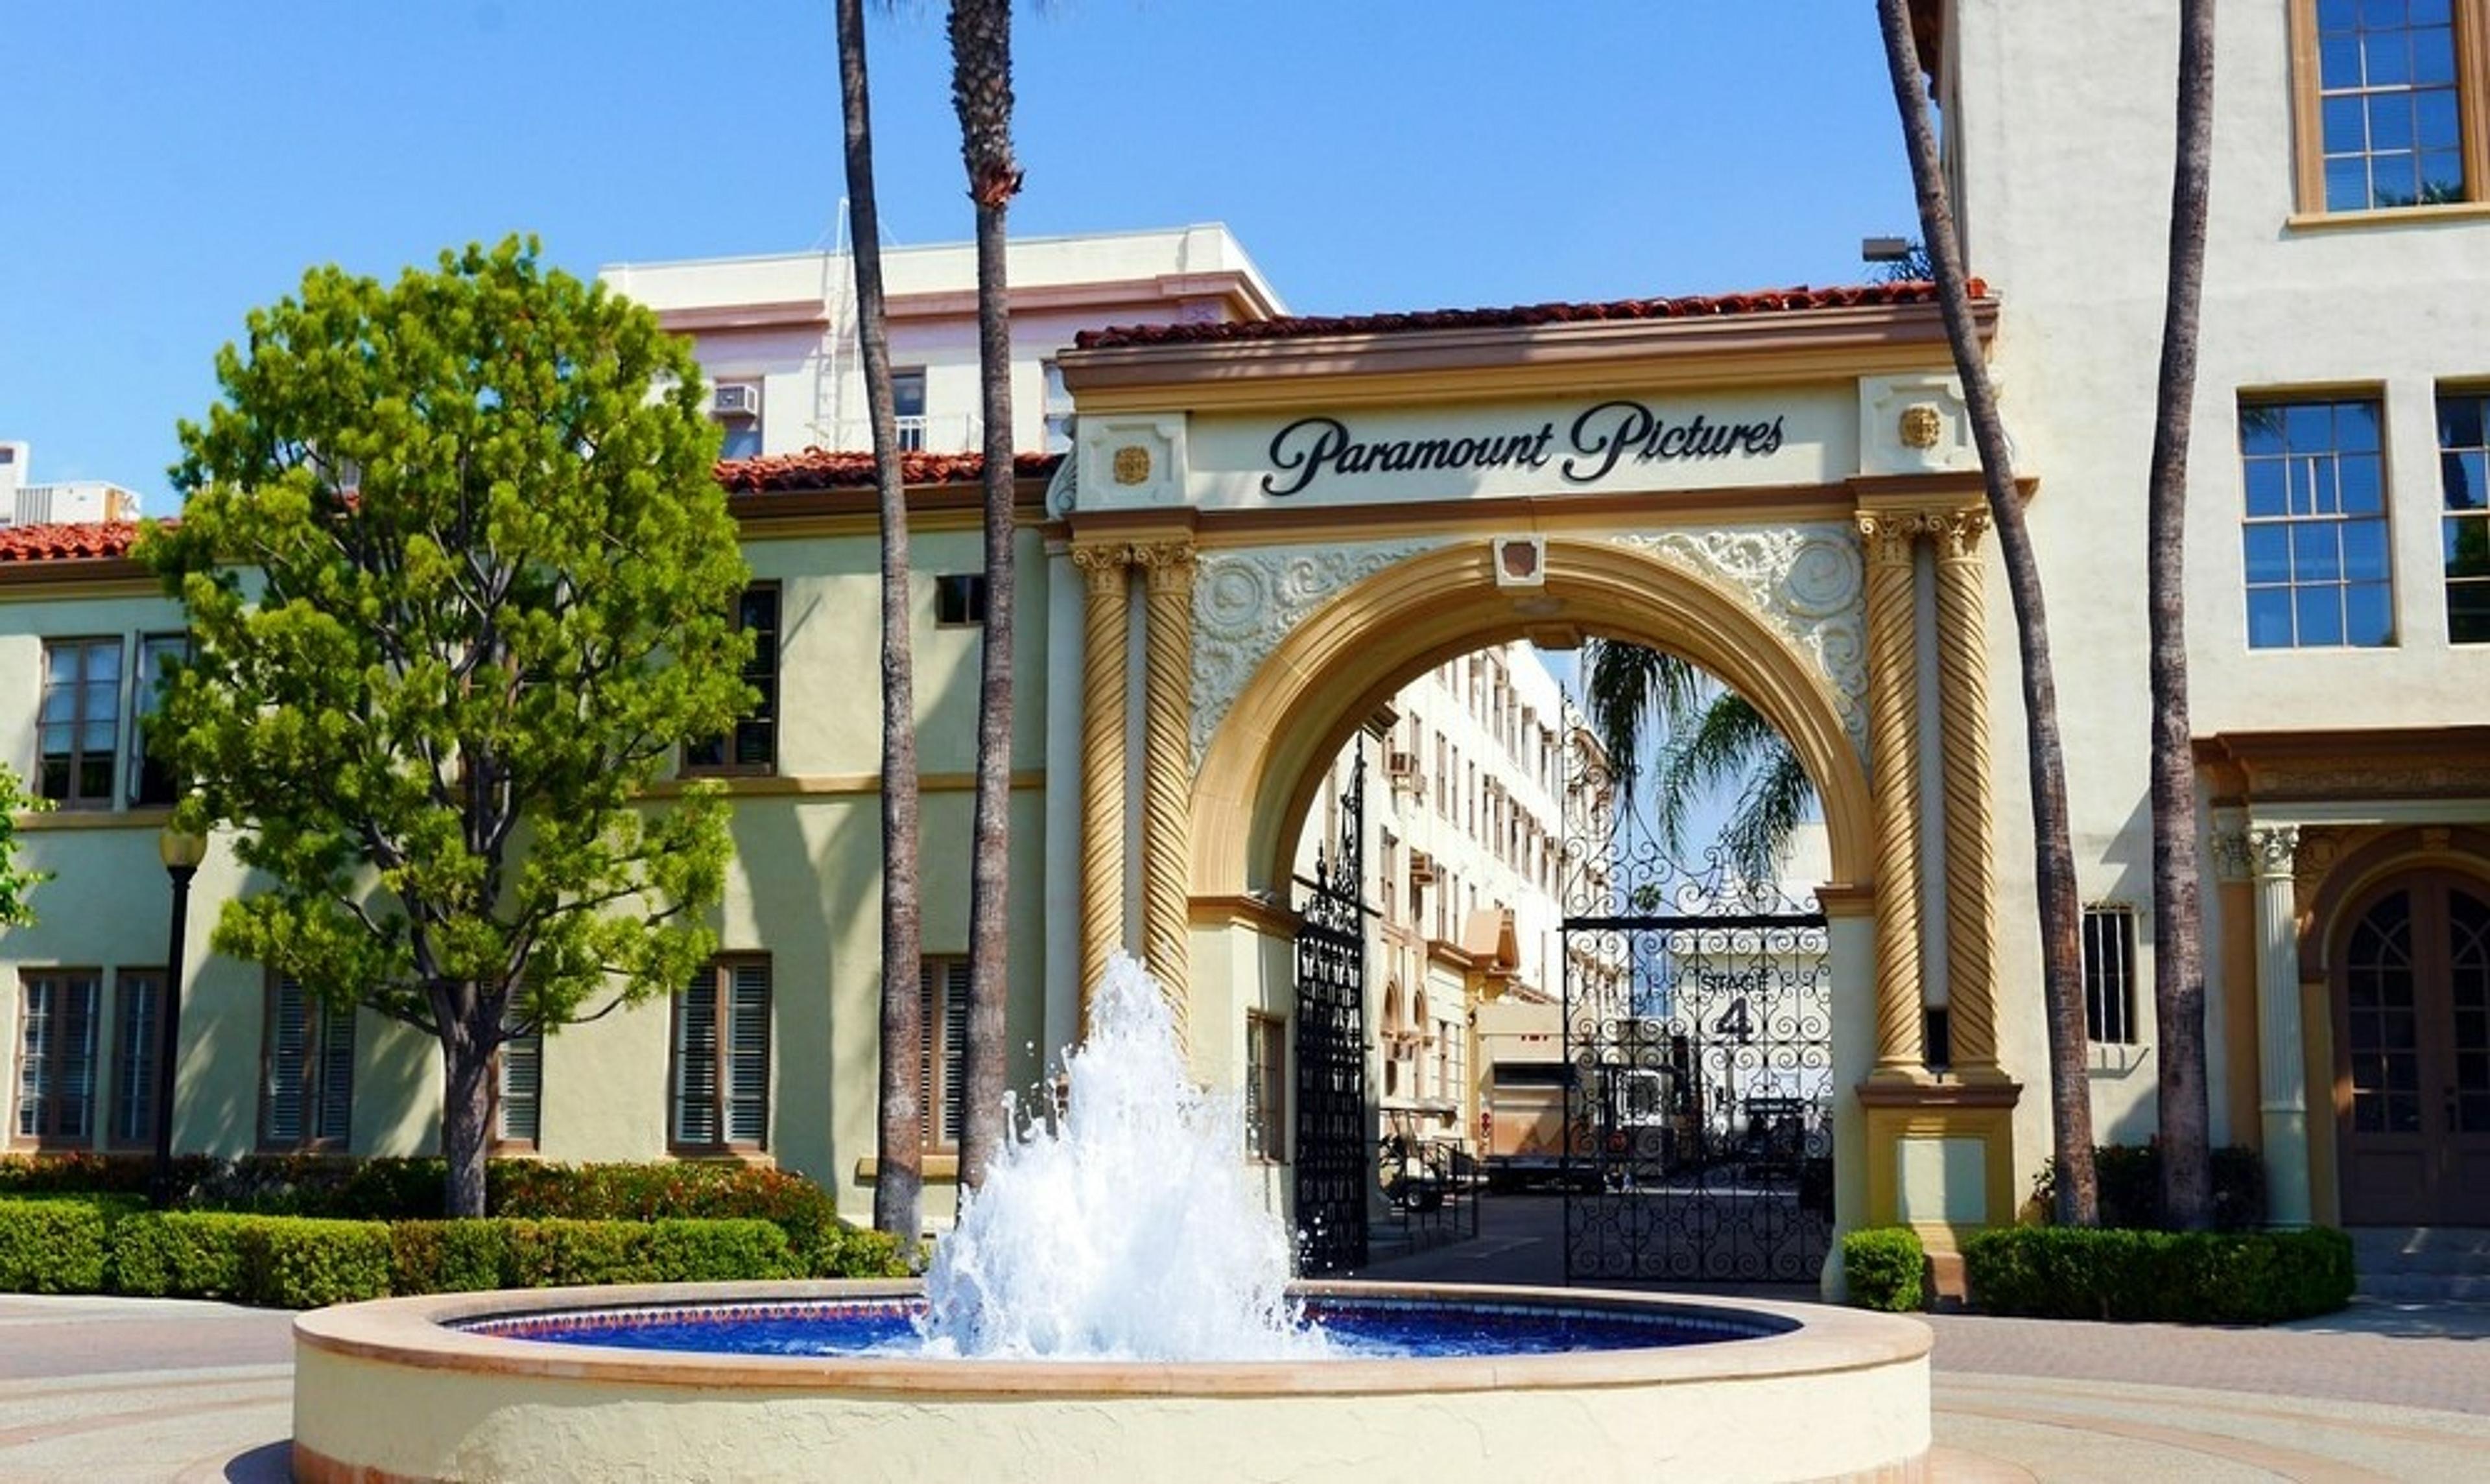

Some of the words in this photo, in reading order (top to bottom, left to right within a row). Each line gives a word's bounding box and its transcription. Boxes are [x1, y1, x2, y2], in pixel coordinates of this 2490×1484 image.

[1261, 416, 1555, 497] Paramount
[1562, 399, 1784, 482] Pictures
[1701, 974, 1769, 992] STAGE
[1716, 996, 1753, 1044] 4
